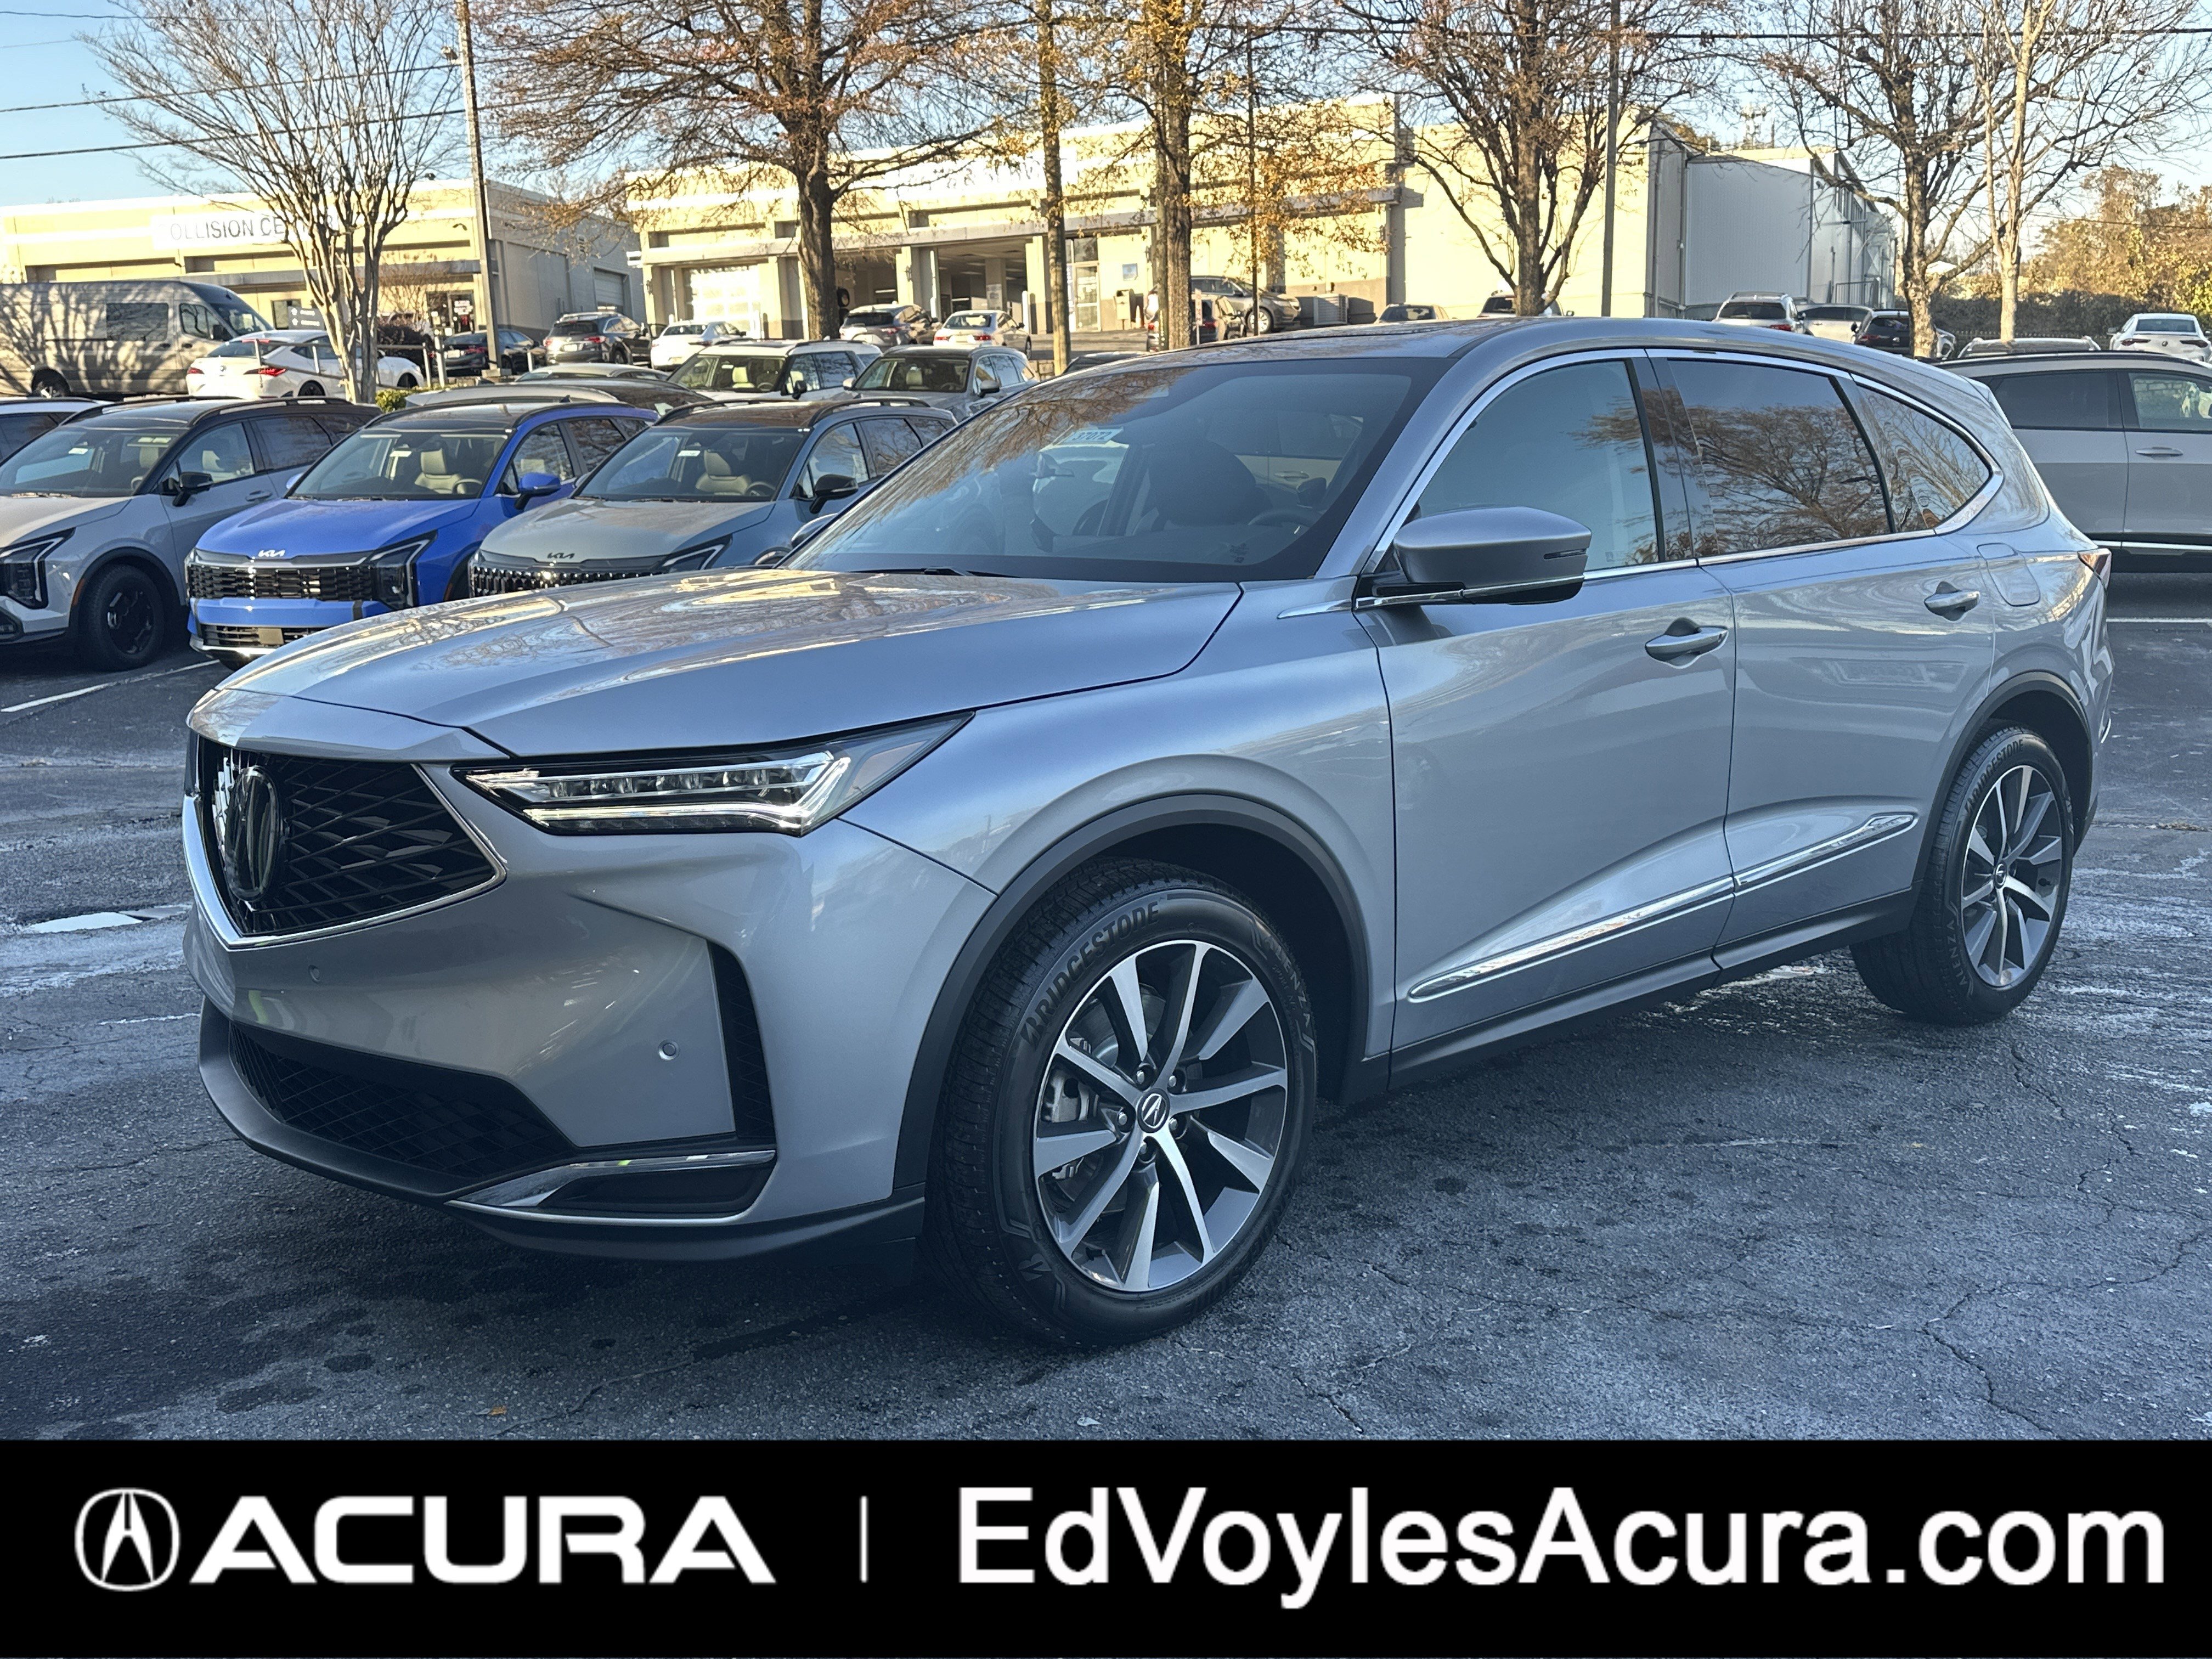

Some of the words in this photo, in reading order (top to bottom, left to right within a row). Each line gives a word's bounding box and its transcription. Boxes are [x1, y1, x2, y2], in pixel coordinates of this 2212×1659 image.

[158, 219, 254, 240] OLLISION
[1020, 901, 1159, 1049] BRIDGESTONE
[1265, 935, 1312, 1028] ALENZA
